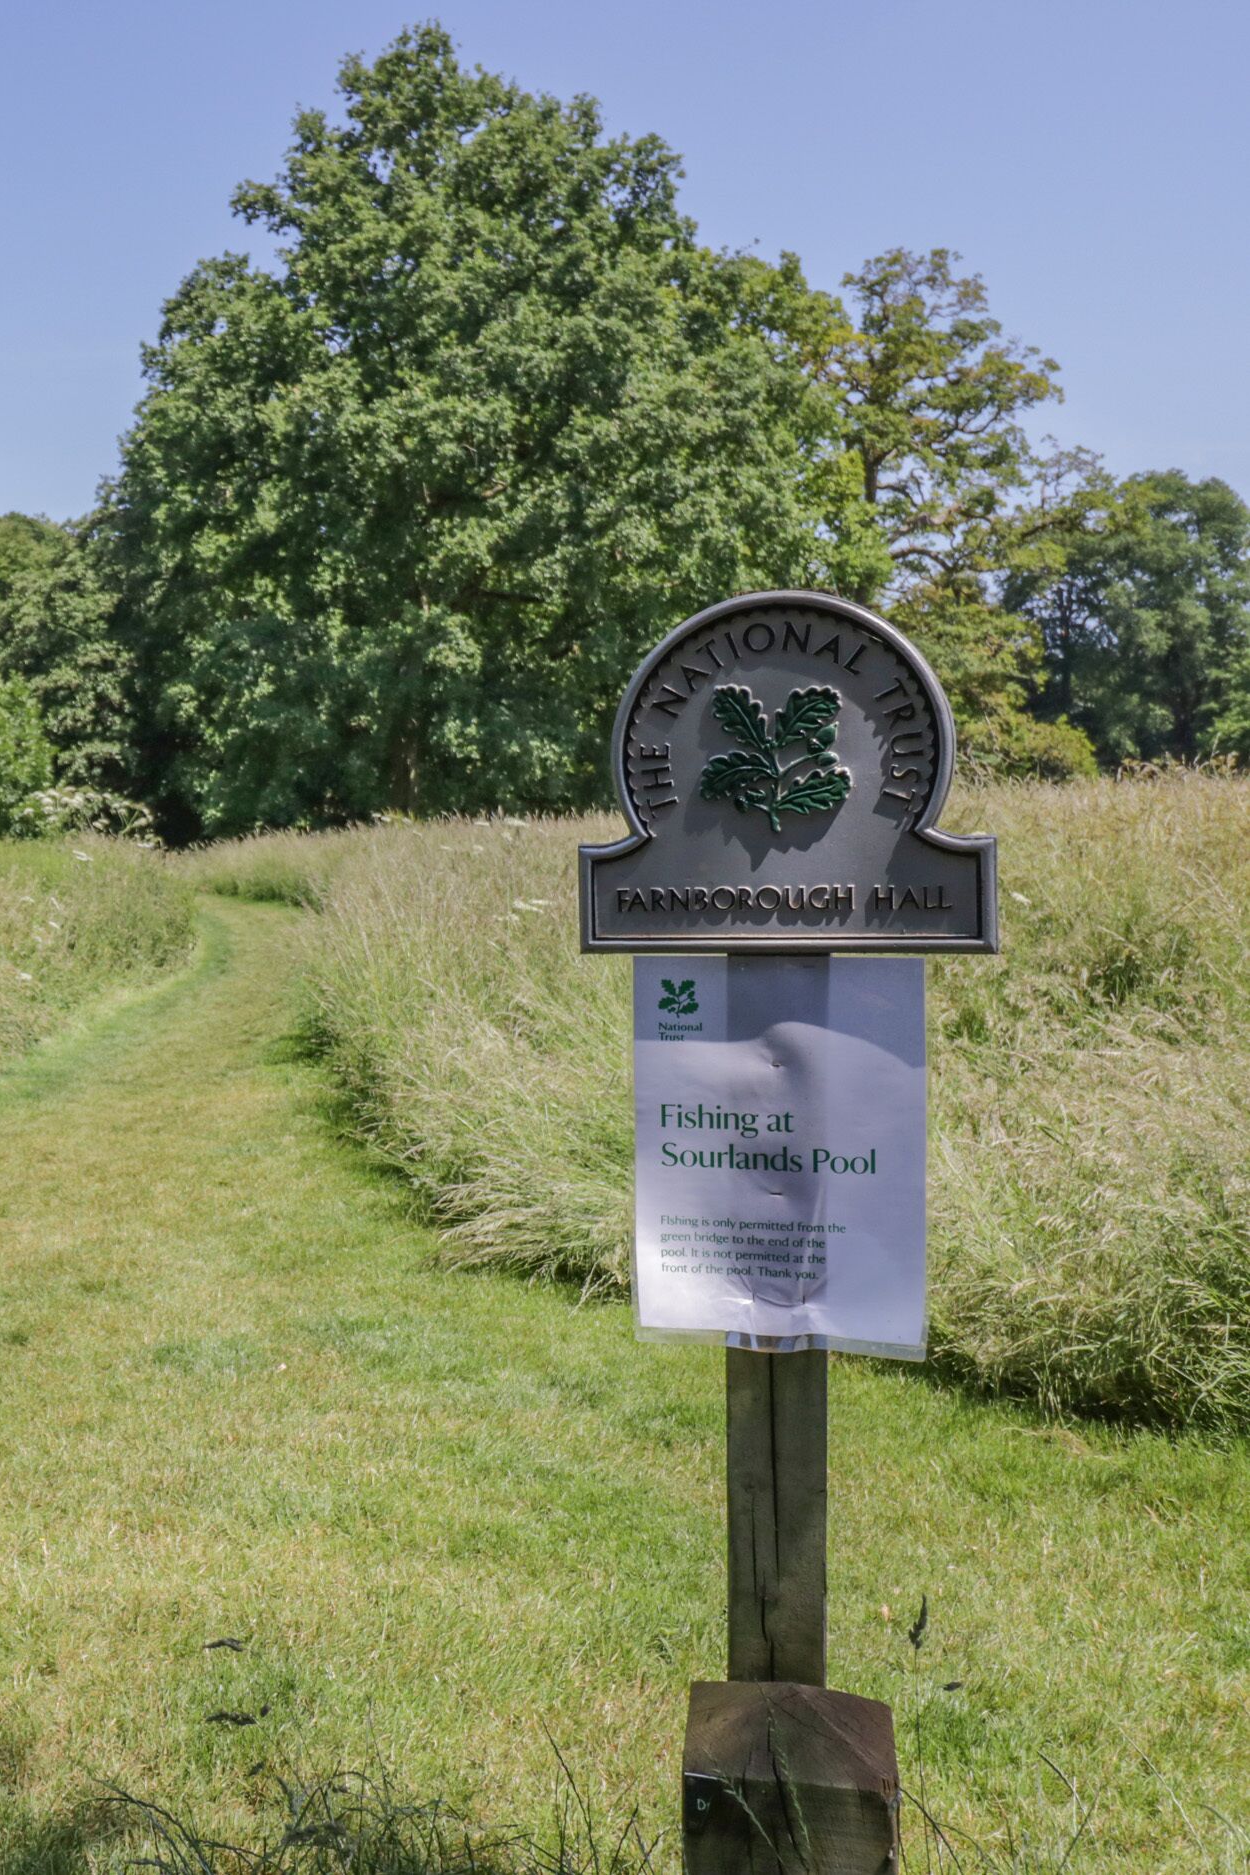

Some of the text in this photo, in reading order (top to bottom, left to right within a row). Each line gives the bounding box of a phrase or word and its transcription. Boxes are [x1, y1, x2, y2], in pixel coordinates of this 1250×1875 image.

[641, 620, 925, 819] THE NATIONAL TRUST
[616, 884, 953, 913] FARNBOROUGH HALL
[658, 1022, 703, 1032] National
[658, 1032, 685, 1042] Trust
[660, 1103, 795, 1139] Fishing at
[661, 1142, 877, 1175] Sourlands Pool
[701, 1216, 710, 1227] is
[712, 1217, 736, 1230] only
[738, 1219, 794, 1232] permitted
[797, 1221, 825, 1233] from
[828, 1222, 847, 1234] the
[660, 1231, 826, 1249] green bridge to the end of the
[691, 1247, 699, 1257] It
[702, 1247, 710, 1258] is
[713, 1250, 733, 1259] not
[735, 1251, 790, 1263] permitted
[792, 1254, 804, 1264] at
[807, 1253, 827, 1265] the
[661, 1261, 688, 1274] front
[690, 1262, 704, 1274] of
[705, 1263, 724, 1275] the
[757, 1265, 792, 1279] Thank
[794, 1270, 820, 1281] you.
